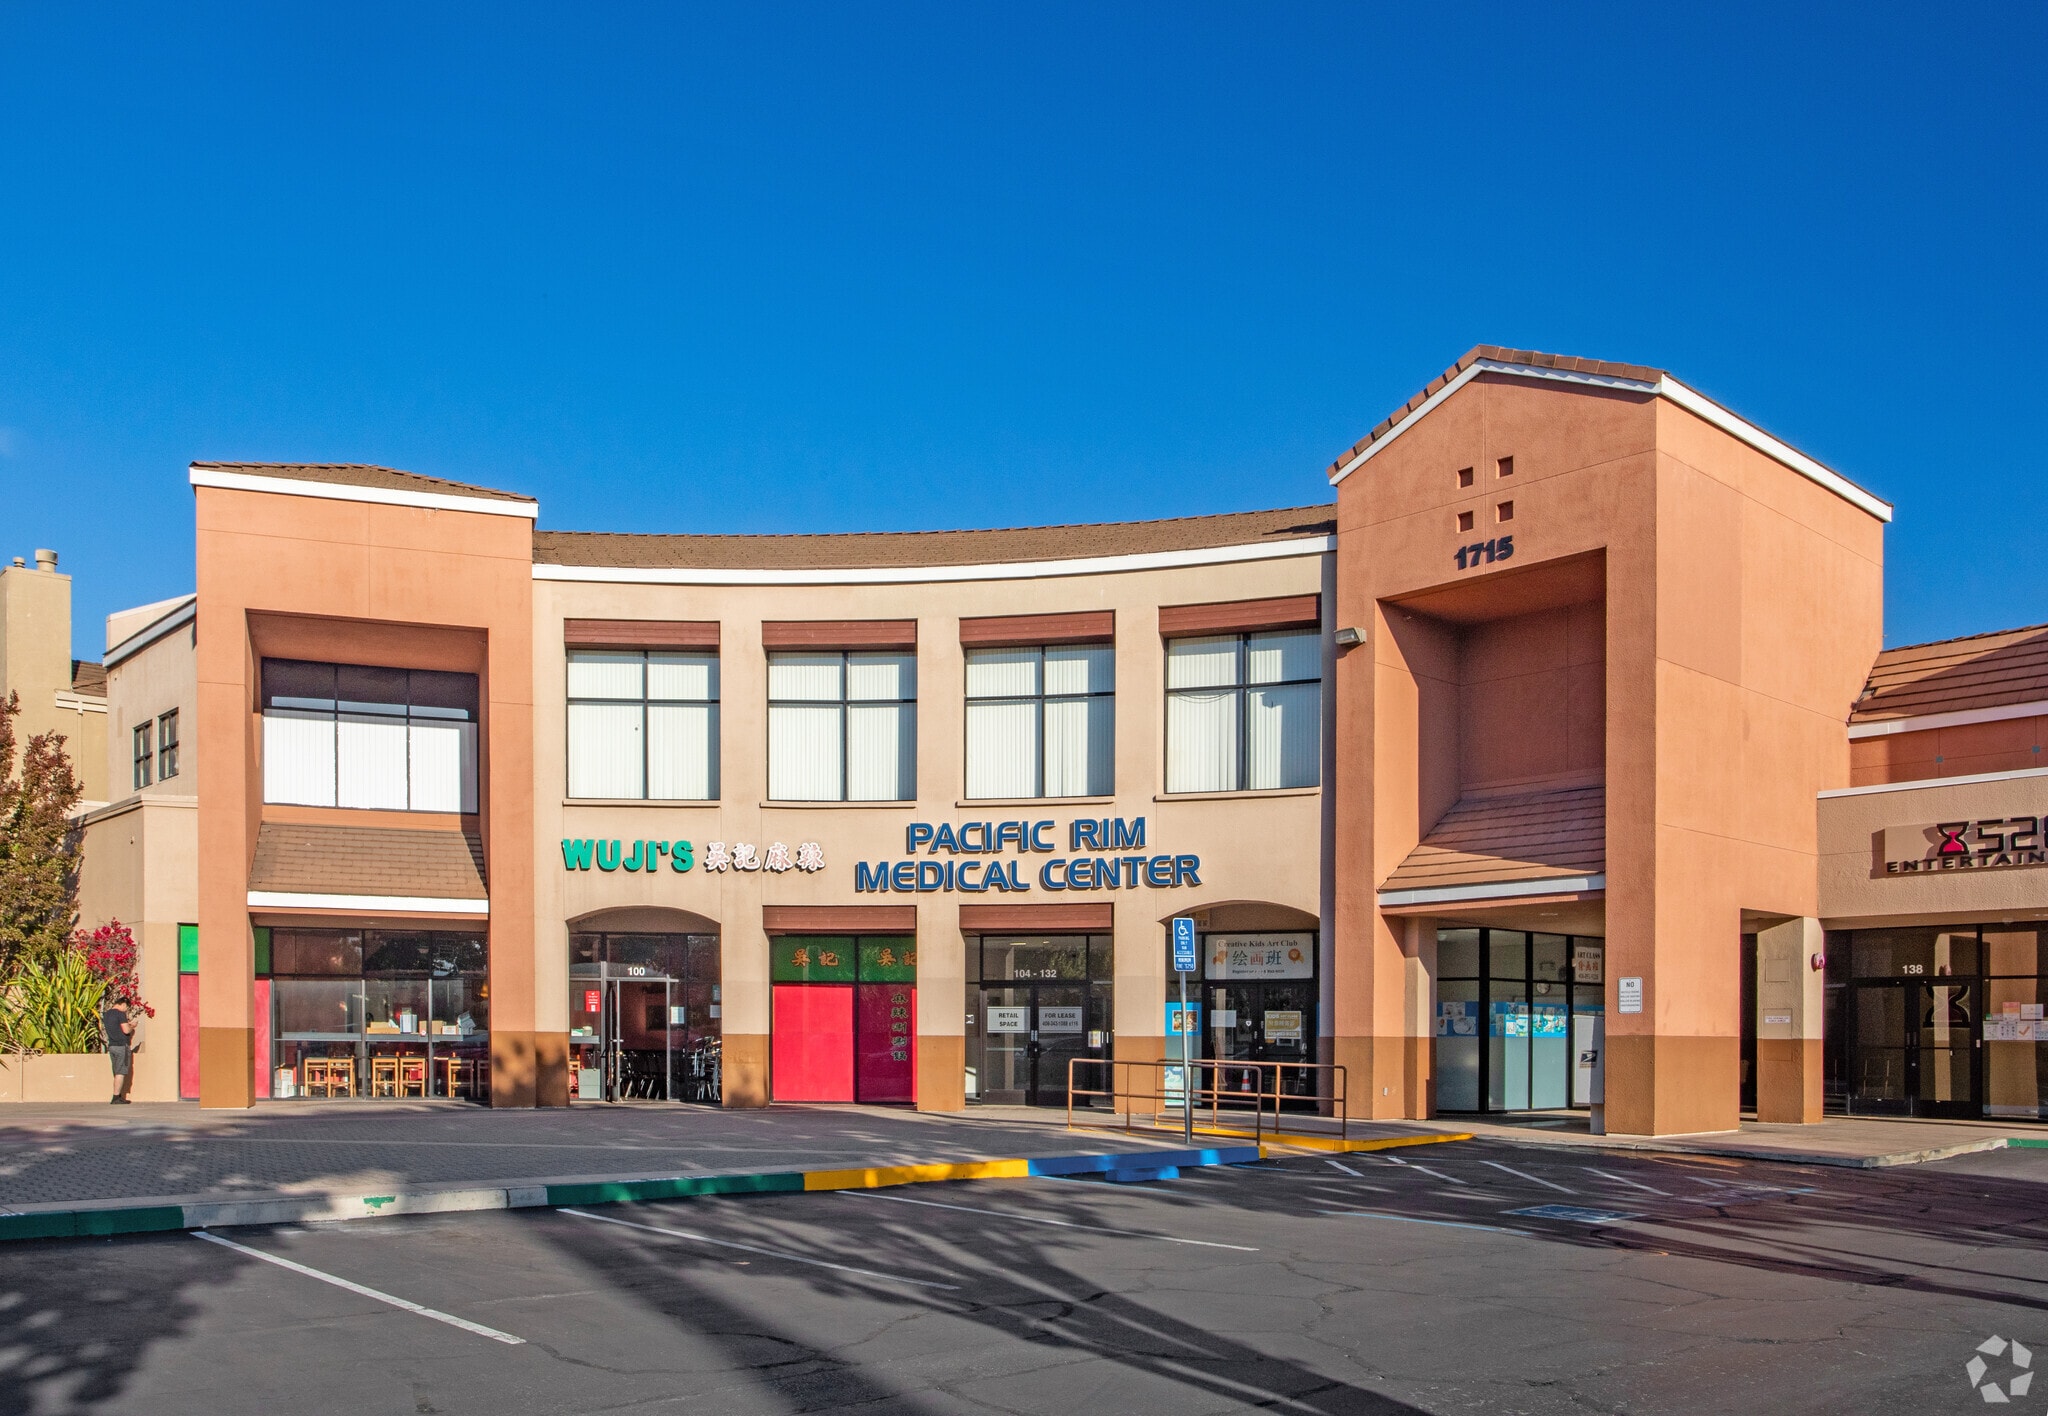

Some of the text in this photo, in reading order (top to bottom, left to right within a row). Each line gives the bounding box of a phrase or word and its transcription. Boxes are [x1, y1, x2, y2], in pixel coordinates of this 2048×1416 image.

[1454, 535, 1514, 570] 1715
[908, 817, 1146, 852] PACIFIC RIM
[1977, 815, 2048, 853] 52
[562, 839, 695, 871] WUJI'S
[857, 854, 1203, 891] MEDICAL CENTER
[627, 966, 645, 976] 100
[1014, 969, 1031, 978] 104
[1040, 969, 1057, 978] 132
[1232, 950, 1282, 966] 绘画班
[1902, 965, 1923, 975] 138
